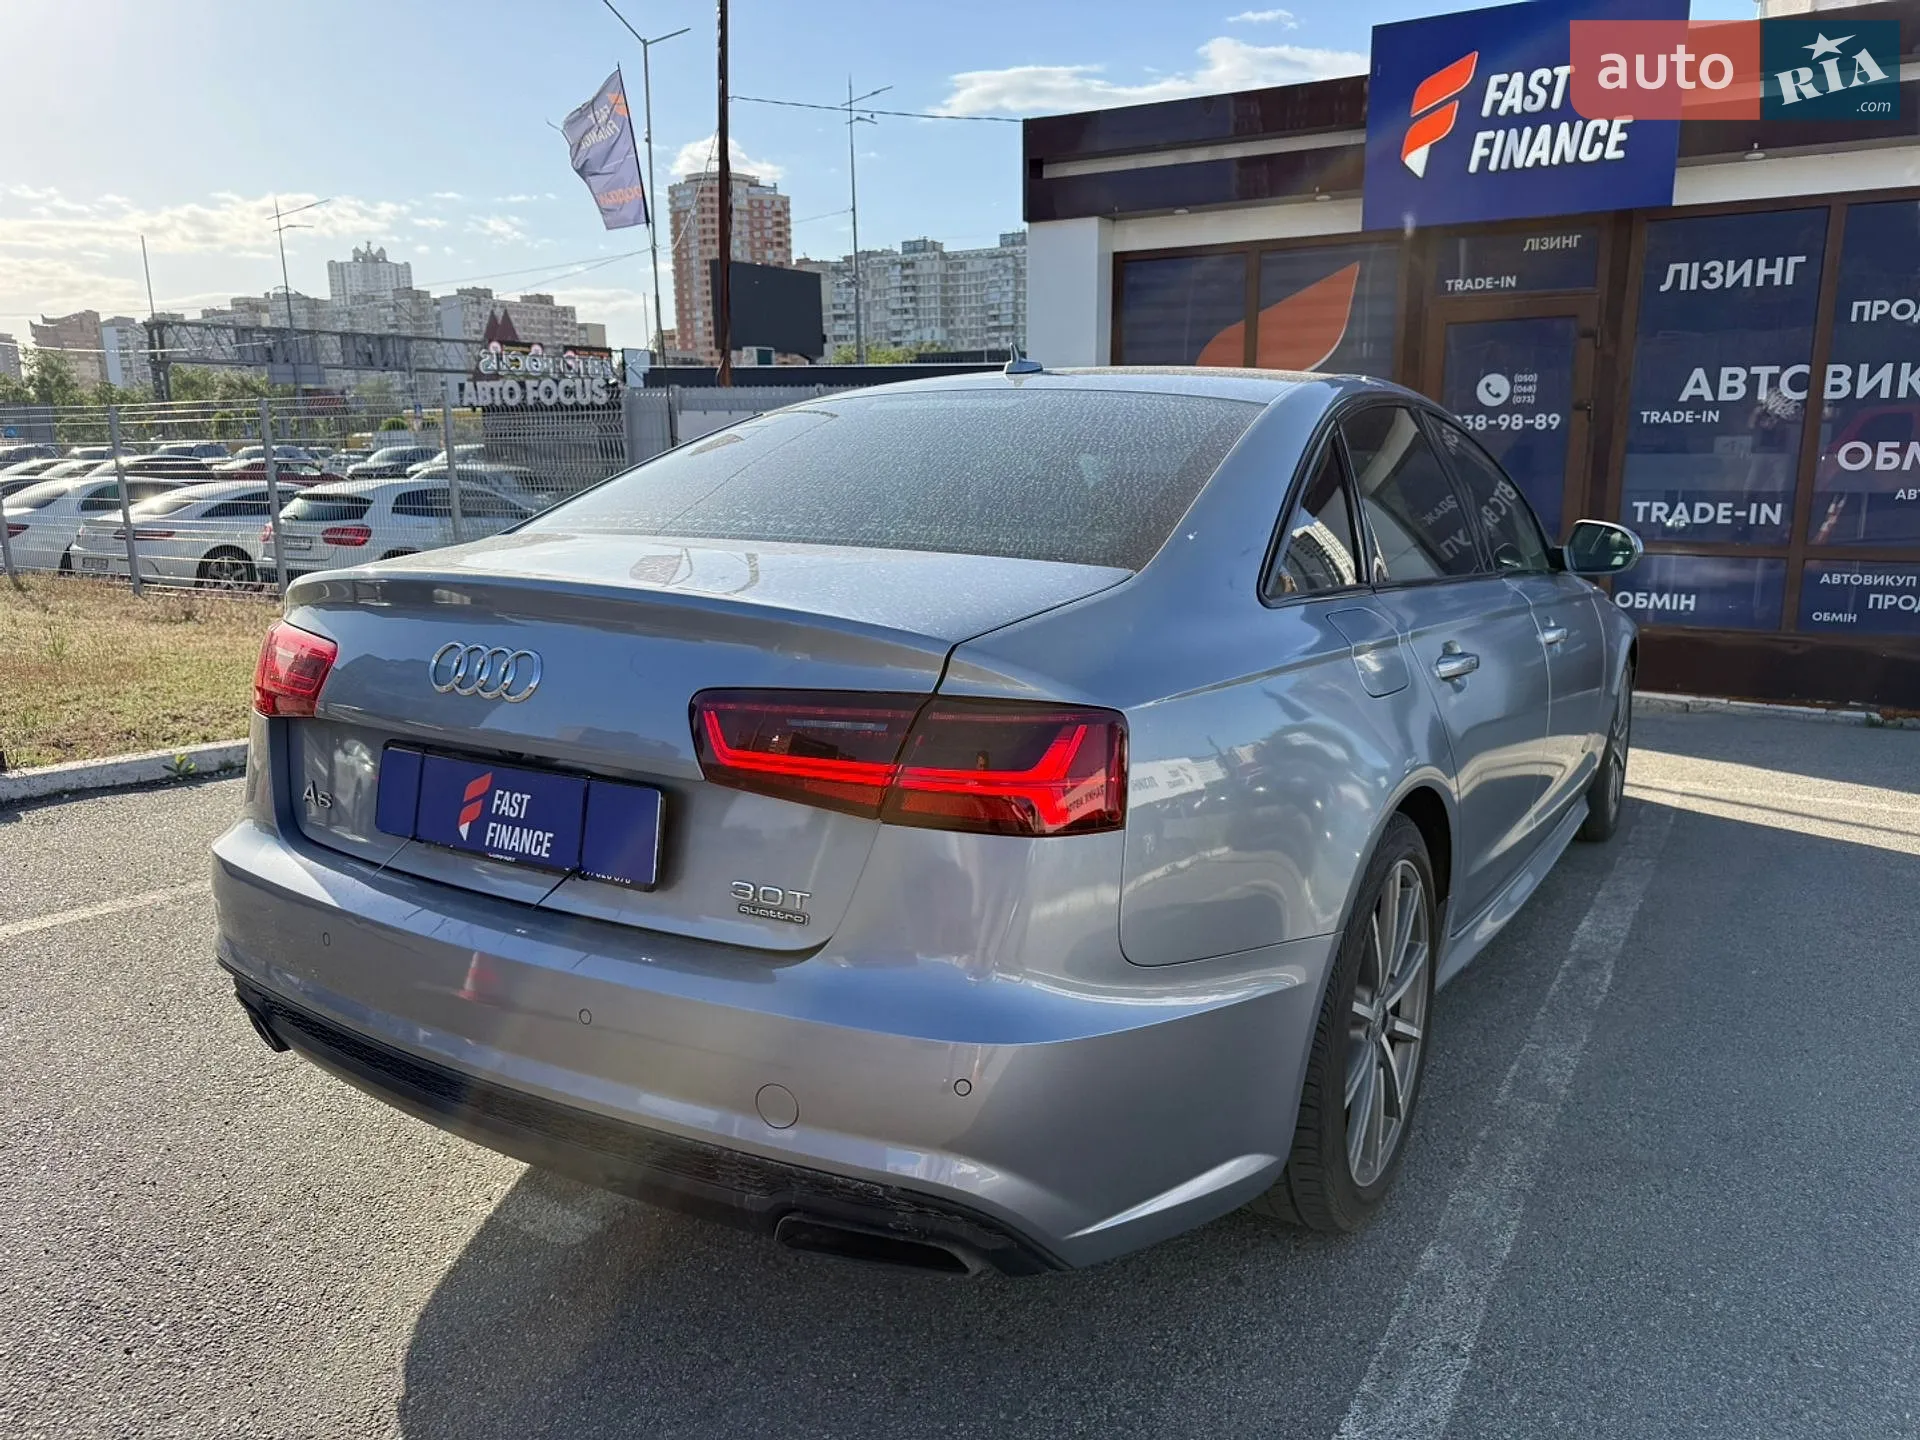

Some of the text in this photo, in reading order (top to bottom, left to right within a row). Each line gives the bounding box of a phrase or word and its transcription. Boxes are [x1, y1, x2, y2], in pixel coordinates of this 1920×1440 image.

[1480, 64, 1576, 118] FAST
[1467, 114, 1634, 174] FINANCE
[1522, 235, 1582, 253] ЛІЗИНГ
[1445, 275, 1517, 292] TRADE-IN
[1659, 256, 1807, 292] ЛІЗИНГ
[525, 377, 610, 406] FOCUS
[1455, 413, 1561, 430] 38-98-89
[1640, 410, 1720, 424] TRADE-IN
[1632, 501, 1783, 526] TRADE-IN
[1819, 573, 1917, 587] АВТОВИКУП
[1614, 590, 1697, 612] ОБМІН
[1867, 593, 1920, 613] ПРО
[1812, 611, 1858, 623] ОБМІН
[302, 779, 333, 809] A6
[491, 788, 532, 821] FAST
[484, 821, 555, 859] FINANCE
[739, 905, 804, 923] quattro
